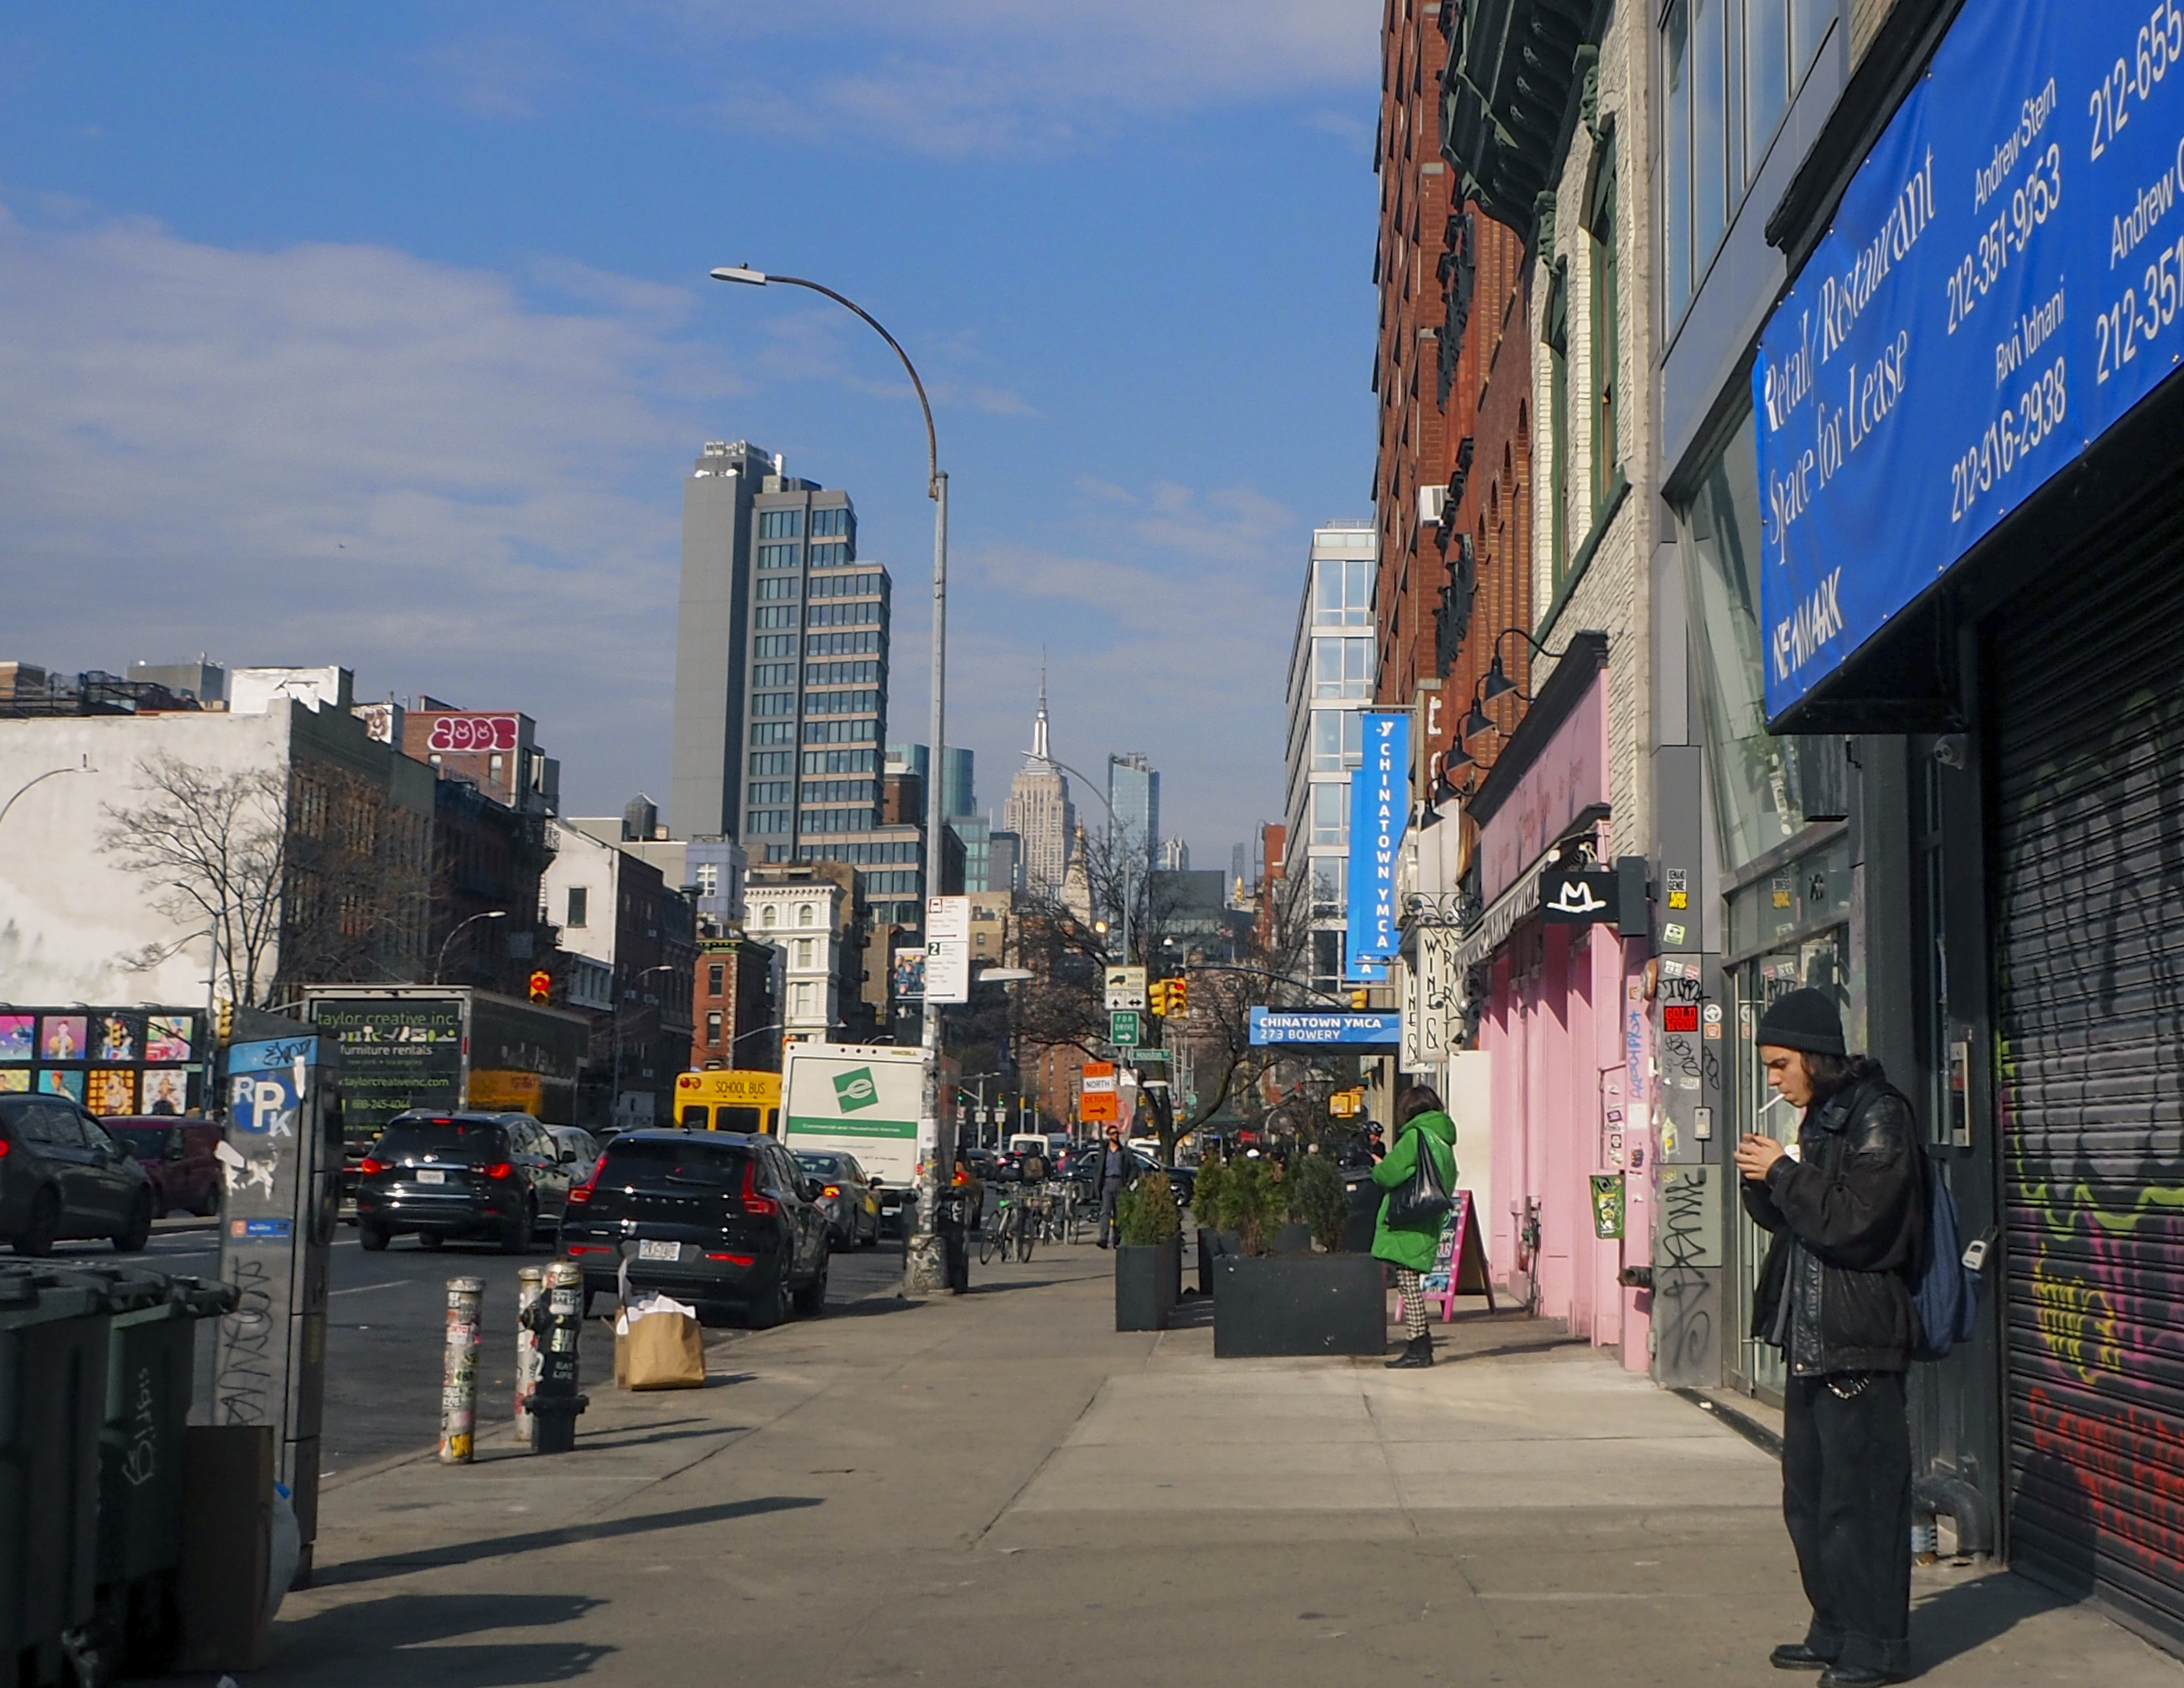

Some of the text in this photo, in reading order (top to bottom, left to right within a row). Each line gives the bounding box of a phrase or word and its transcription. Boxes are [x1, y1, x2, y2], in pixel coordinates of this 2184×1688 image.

[1974, 125, 2020, 216] Andrew
[2110, 166, 2176, 271] Andrew
[2021, 274, 2064, 361] Idnani
[1951, 356, 2067, 523] 212-916-2938
[1769, 329, 1908, 566] Space for Lease
[1377, 742, 1391, 879] CHINATOWN
[1377, 888, 1389, 948] YMCA
[1424, 938, 1439, 1050] WINE &
[1442, 931, 1453, 1057] SPIRITS
[318, 1011, 459, 1029] taylor creative inc.
[1665, 1007, 1696, 1019] GOLD
[1260, 1017, 1382, 1028] CHINATOWN YMCA
[1665, 1019, 1696, 1031] WOOD
[1260, 1029, 1341, 1040] 273 BOWERY
[340, 1045, 433, 1056] furniture rentals
[1136, 1050, 1163, 1058] Houston
[1085, 1066, 1110, 1074] FDR DR
[715, 1081, 765, 1094] SCHOOL BUS
[1086, 1079, 1111, 1088] NORTH
[1084, 1094, 1113, 1104] DETOUR
